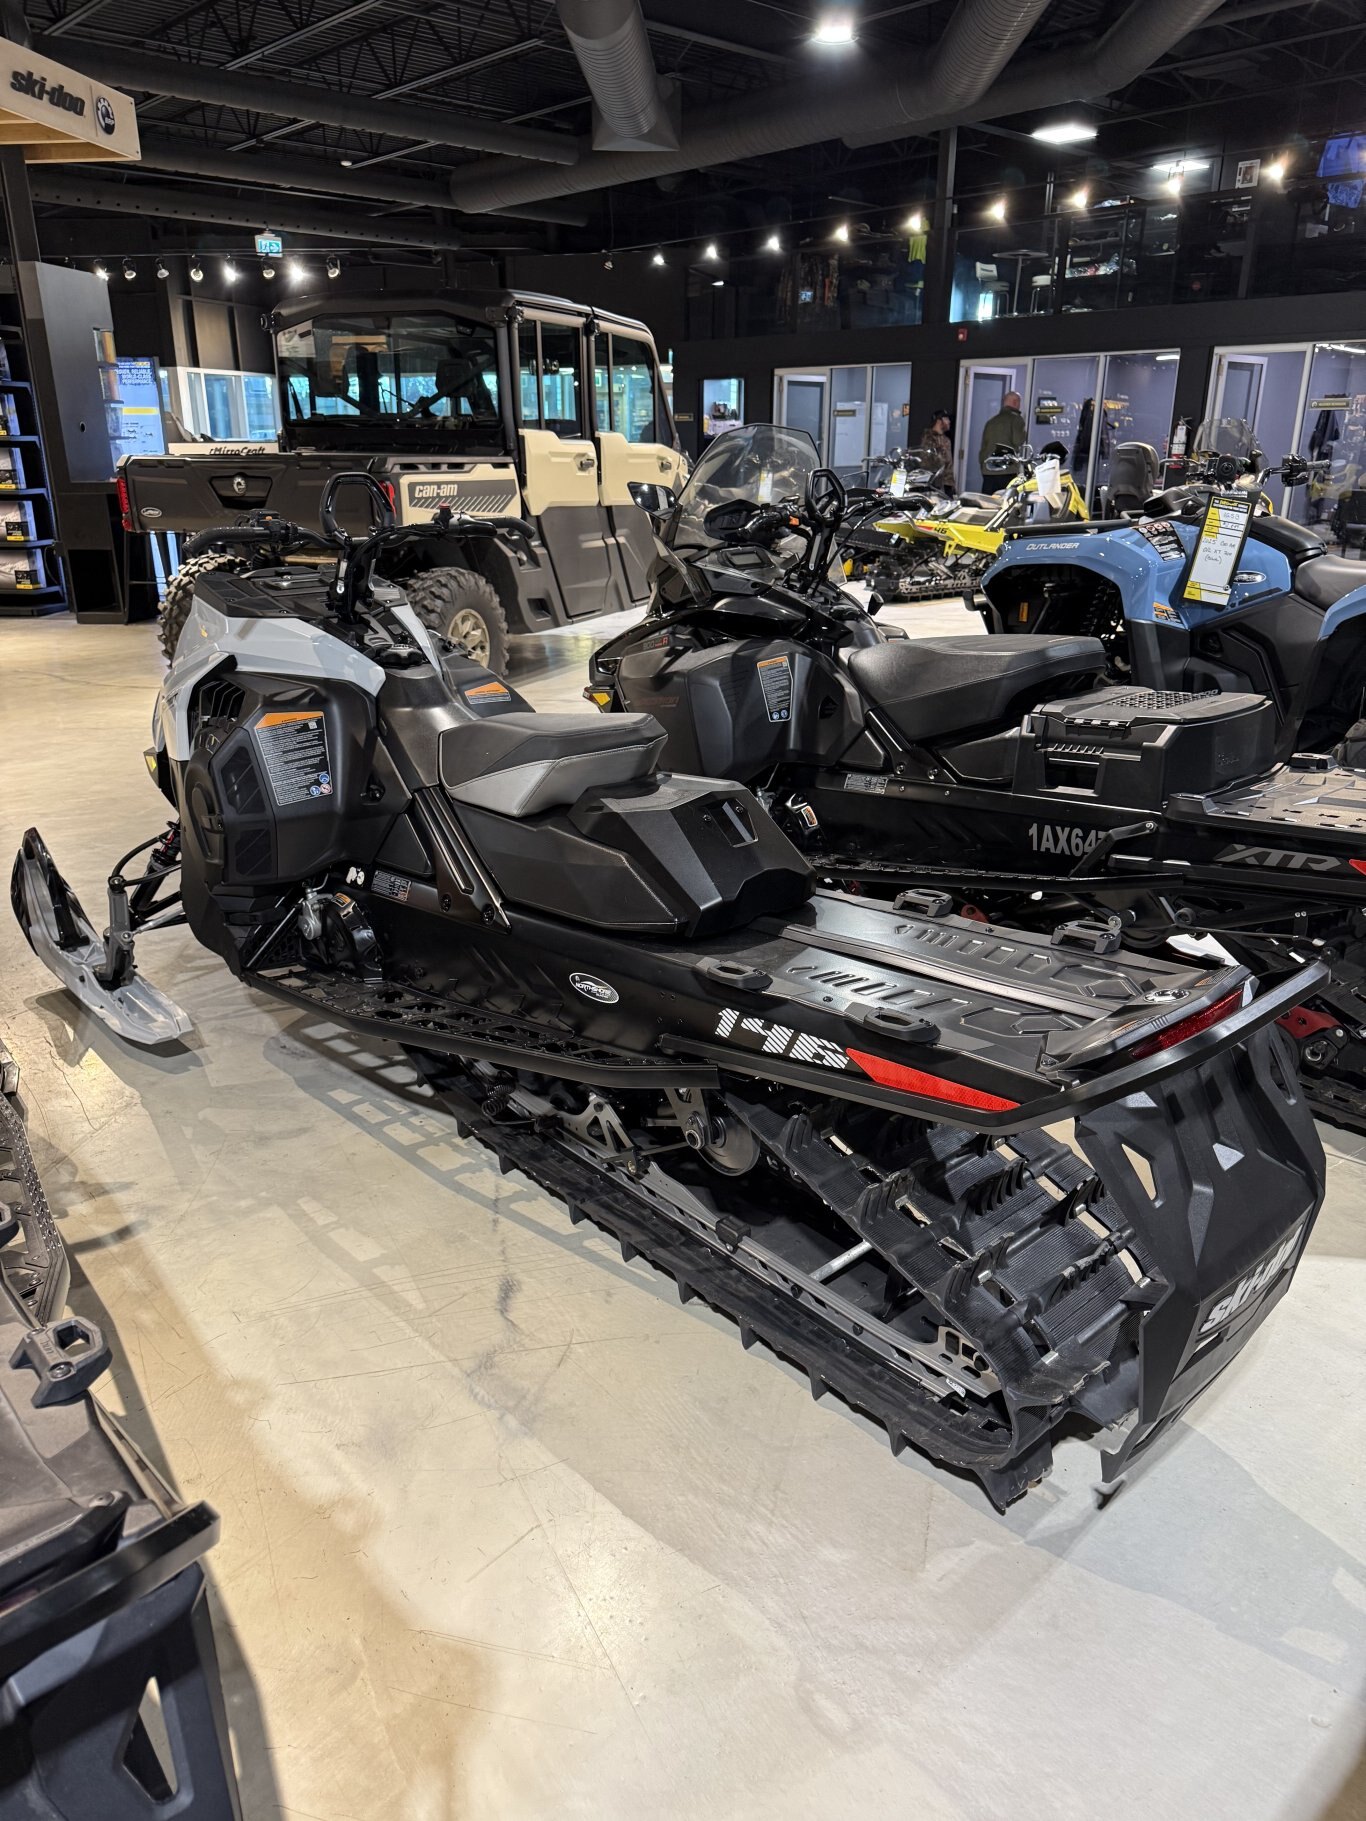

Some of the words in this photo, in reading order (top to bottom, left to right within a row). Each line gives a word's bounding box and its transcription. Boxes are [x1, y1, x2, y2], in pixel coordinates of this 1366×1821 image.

[10, 71, 85, 117] ski-doo
[415, 484, 458, 498] can-am
[1026, 542, 1080, 551] OUTLANDER
[1213, 844, 1342, 871] XTR
[714, 1007, 850, 1070] 146
